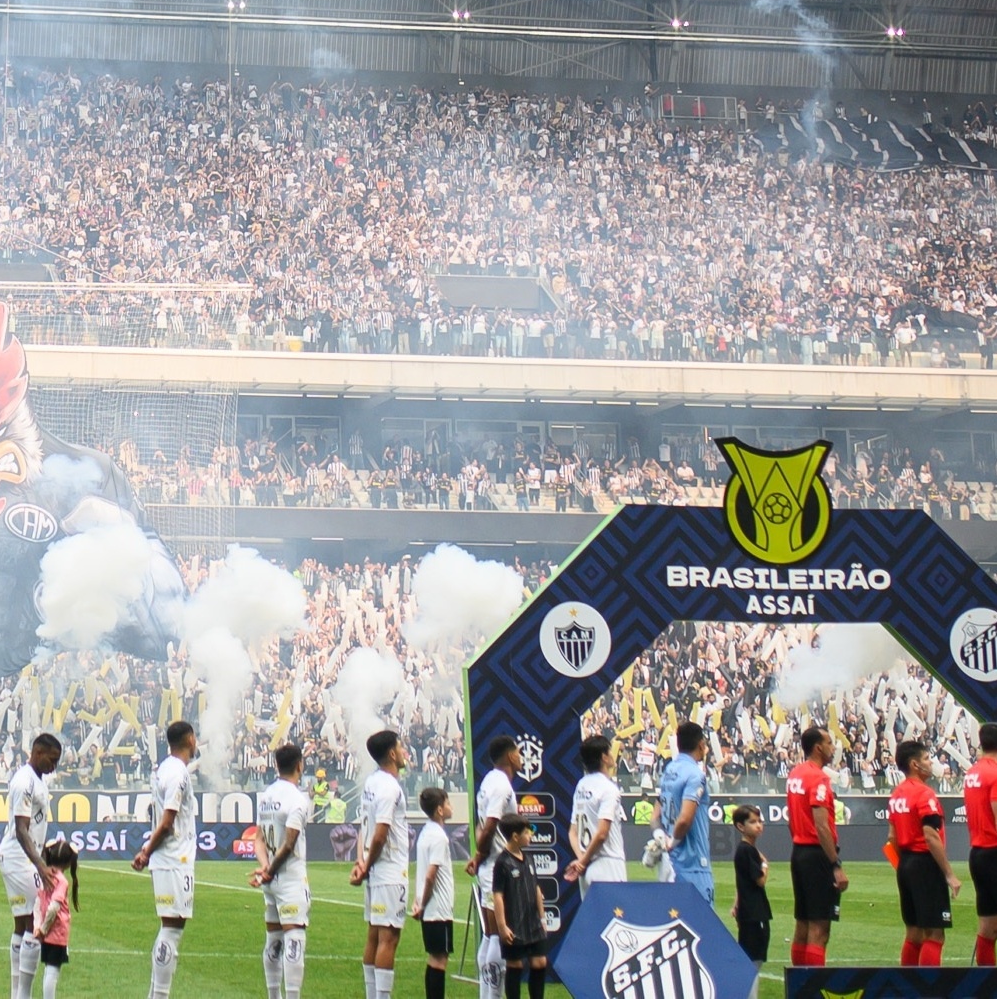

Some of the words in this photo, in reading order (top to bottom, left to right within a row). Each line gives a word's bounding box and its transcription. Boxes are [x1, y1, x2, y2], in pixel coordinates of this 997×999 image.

[8, 507, 54, 539] CAM
[666, 563, 892, 590] BRASILEIRÃO
[746, 594, 815, 615] ASSAÍ
[560, 630, 590, 640] CAM
[889, 798, 909, 813] TCL
[55, 829, 127, 851] ASSAÍ
[33, 873, 41, 888] 8
[183, 875, 193, 892] 31
[400, 886, 406, 903] 2
[612, 930, 687, 993] S.F.C.
